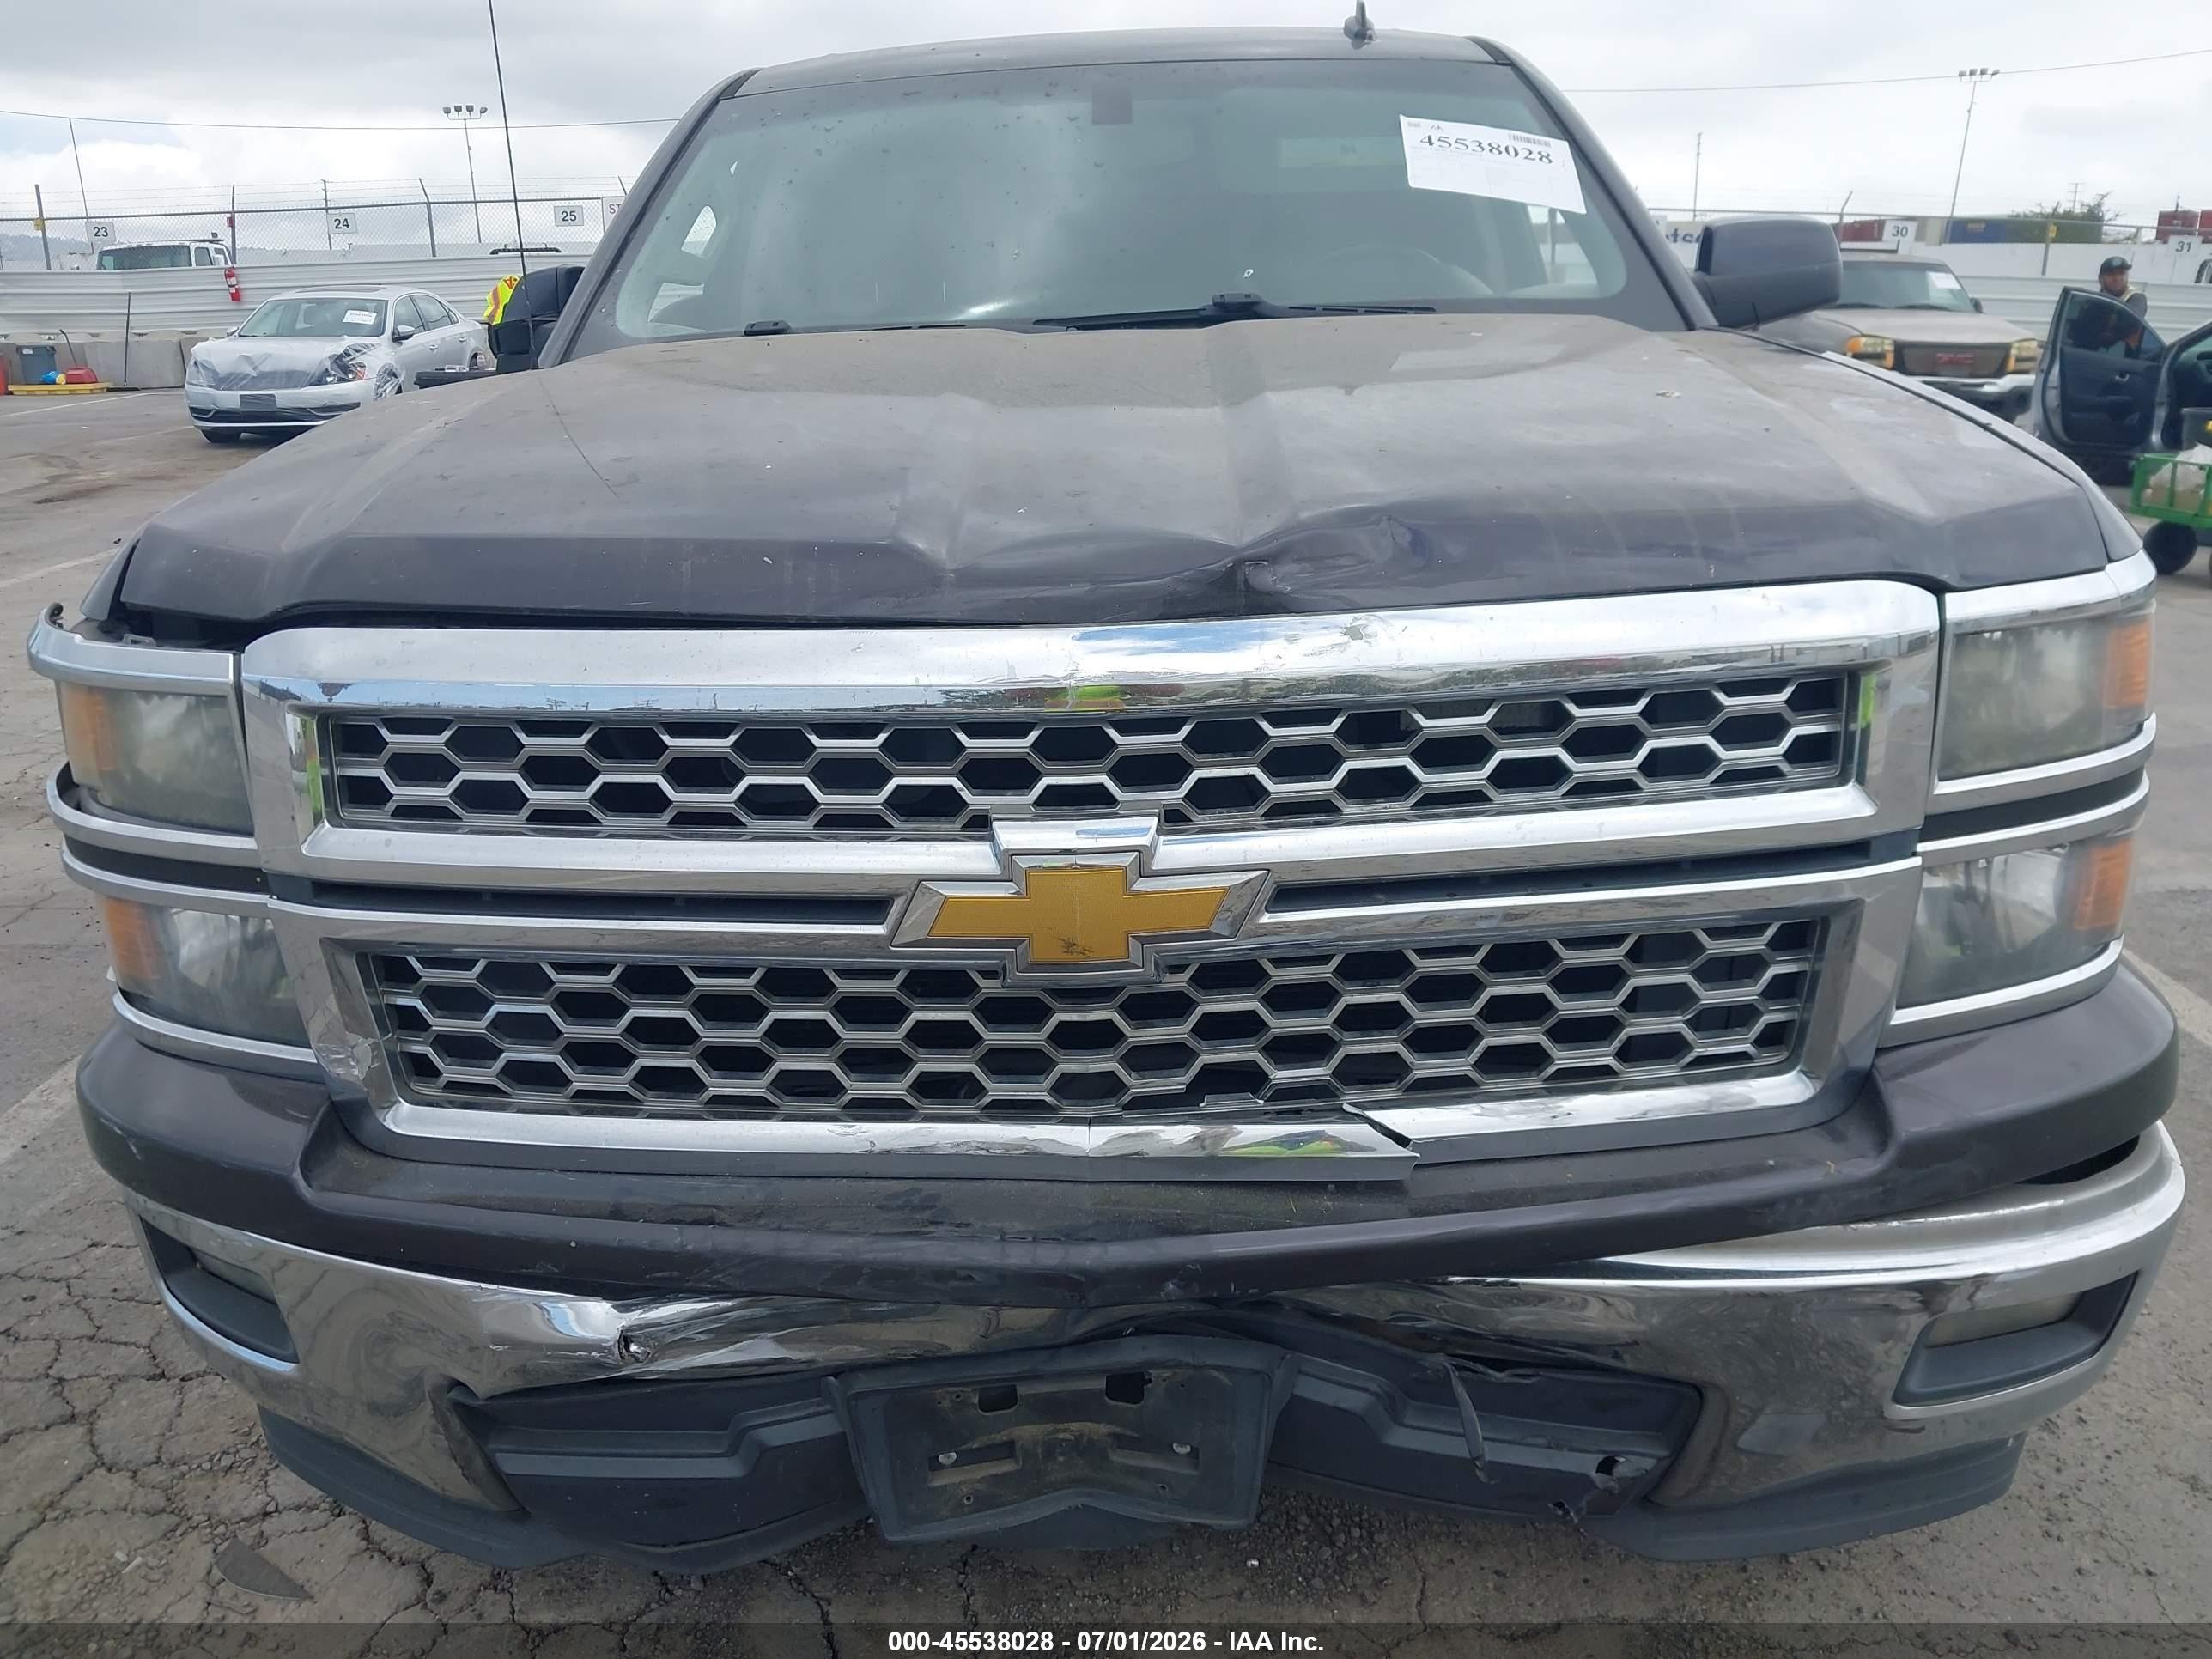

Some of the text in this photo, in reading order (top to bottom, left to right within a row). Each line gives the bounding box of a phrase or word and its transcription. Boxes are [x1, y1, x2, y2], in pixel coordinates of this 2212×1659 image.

[1419, 134, 1553, 165] 45538028
[561, 210, 577, 222] 25
[333, 218, 349, 229] 24
[93, 226, 109, 238] 23
[1892, 225, 1909, 238] 30
[2175, 240, 2192, 252] 31
